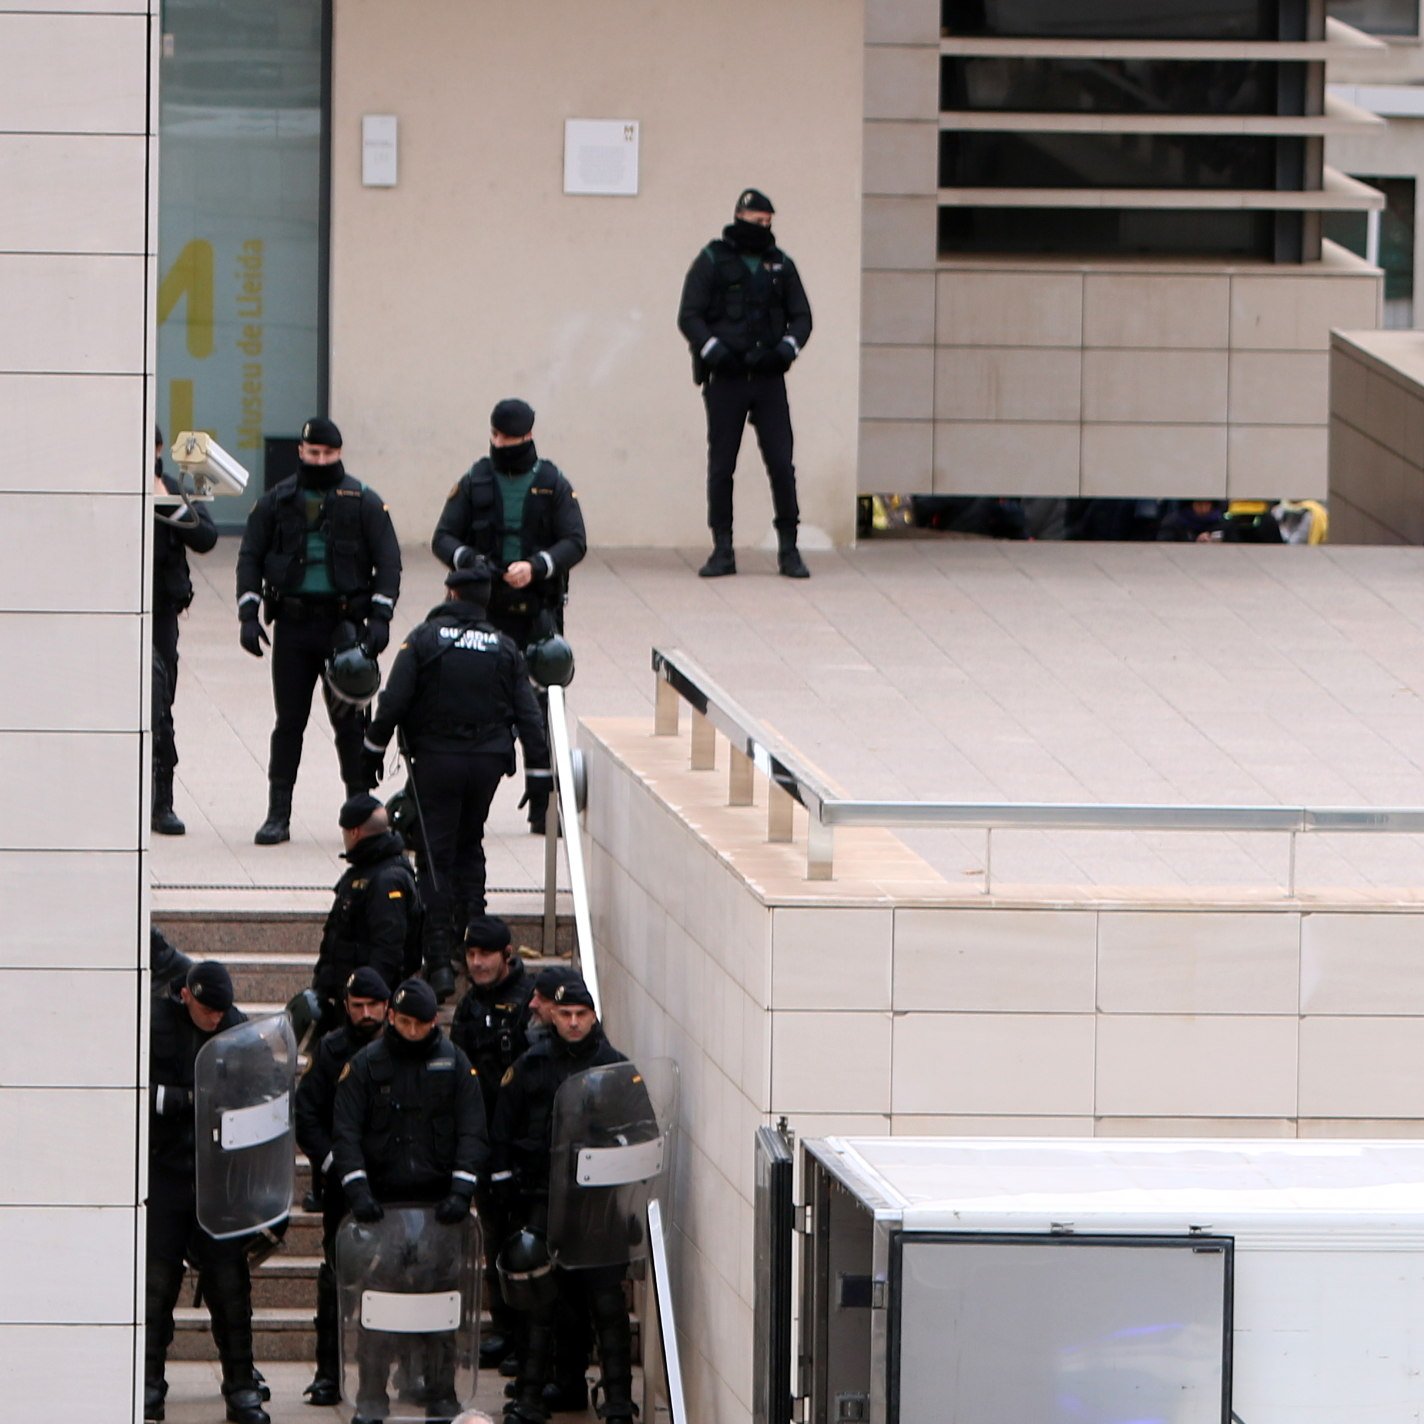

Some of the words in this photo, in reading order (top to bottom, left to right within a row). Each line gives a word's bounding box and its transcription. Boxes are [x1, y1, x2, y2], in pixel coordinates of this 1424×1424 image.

[235, 238, 264, 318] Lleida
[236, 323, 262, 356] de
[237, 362, 262, 449] Museu
